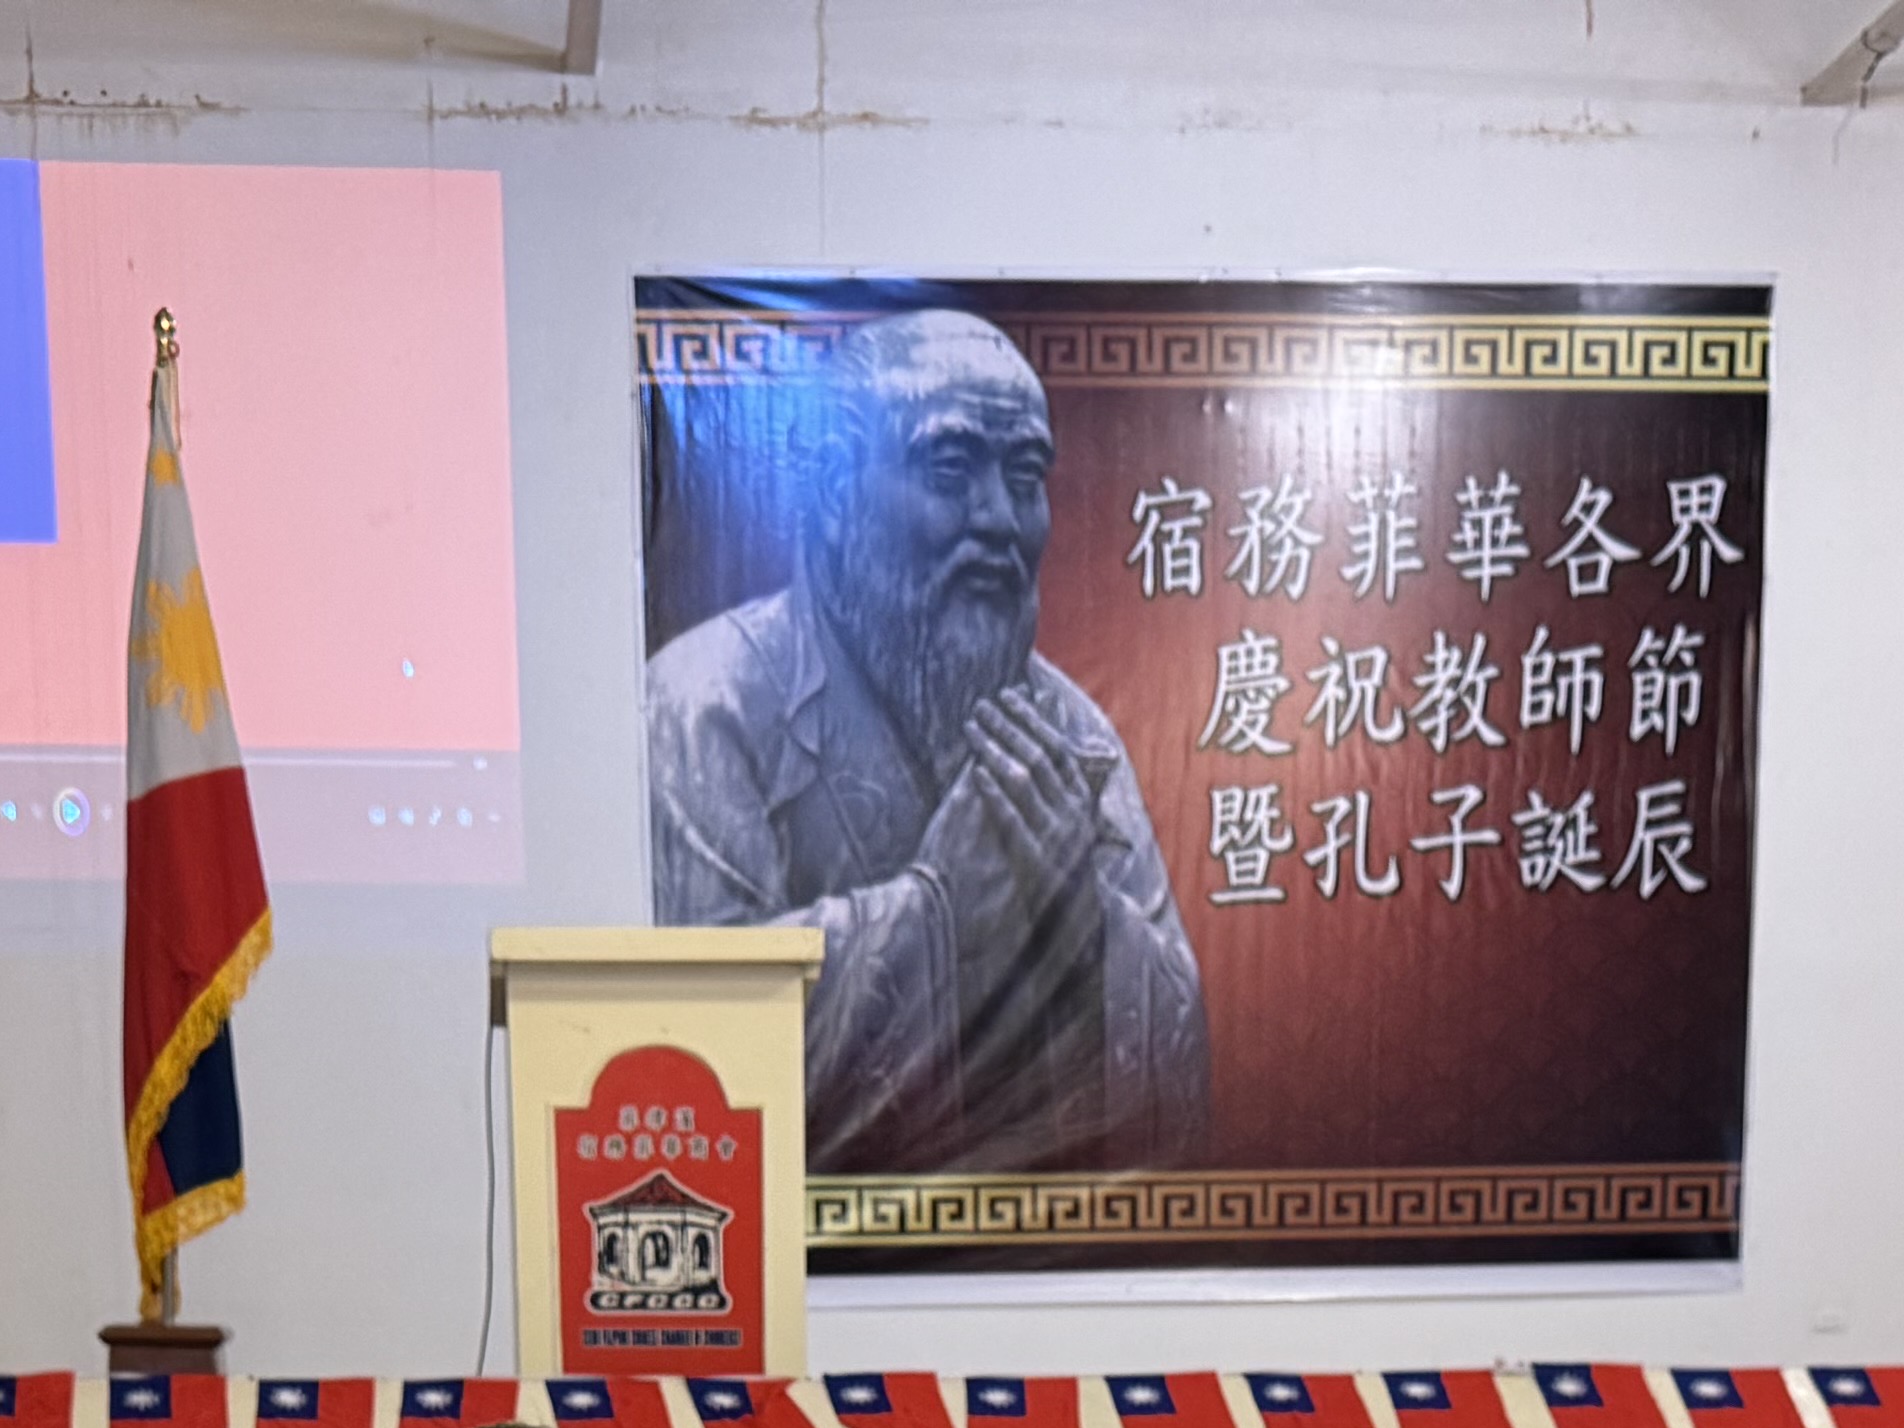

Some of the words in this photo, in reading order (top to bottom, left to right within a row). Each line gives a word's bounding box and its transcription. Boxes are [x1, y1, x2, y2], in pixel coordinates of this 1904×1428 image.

[1126, 470, 1746, 600] 宿務菲華各界
[1198, 622, 1705, 757] 慶祝教師節
[1208, 779, 1708, 905] 暨孔子誕辰
